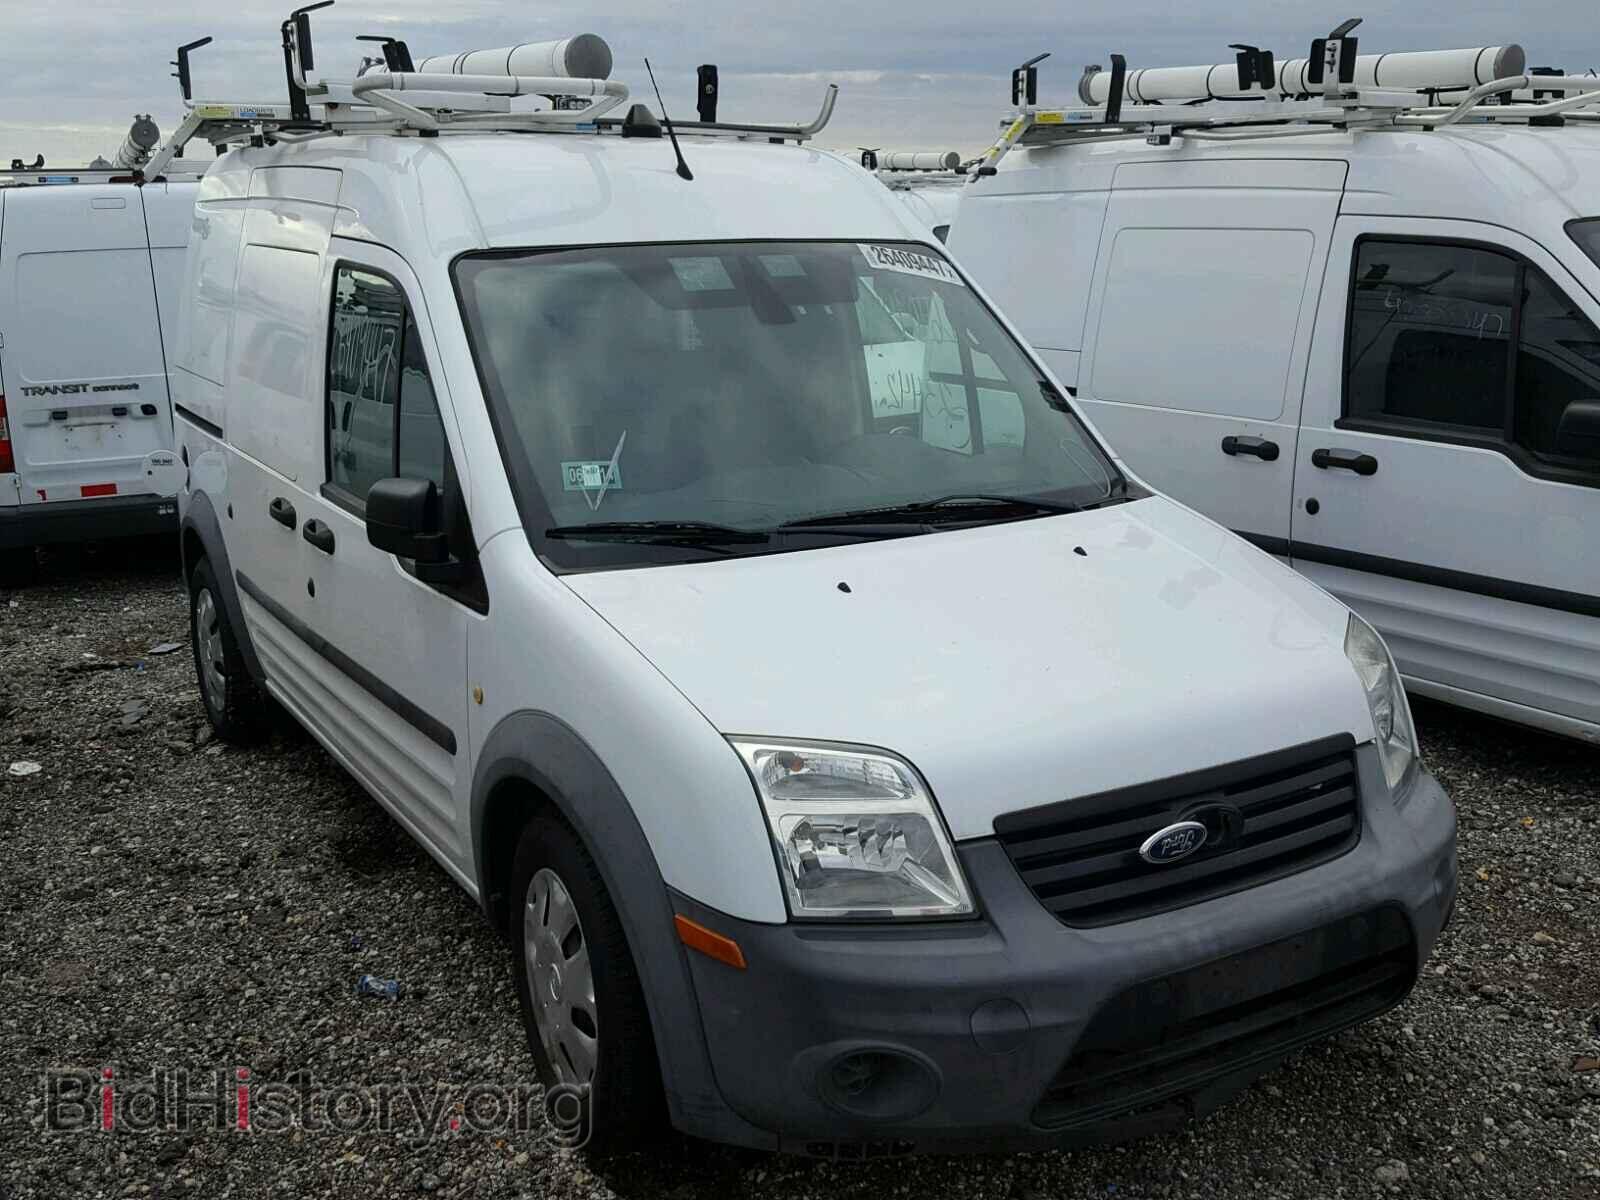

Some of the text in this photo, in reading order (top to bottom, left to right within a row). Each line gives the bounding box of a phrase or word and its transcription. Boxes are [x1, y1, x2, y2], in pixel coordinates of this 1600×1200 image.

[870, 246, 947, 277] 26409447
[21, 383, 139, 396] TRANSIT connect
